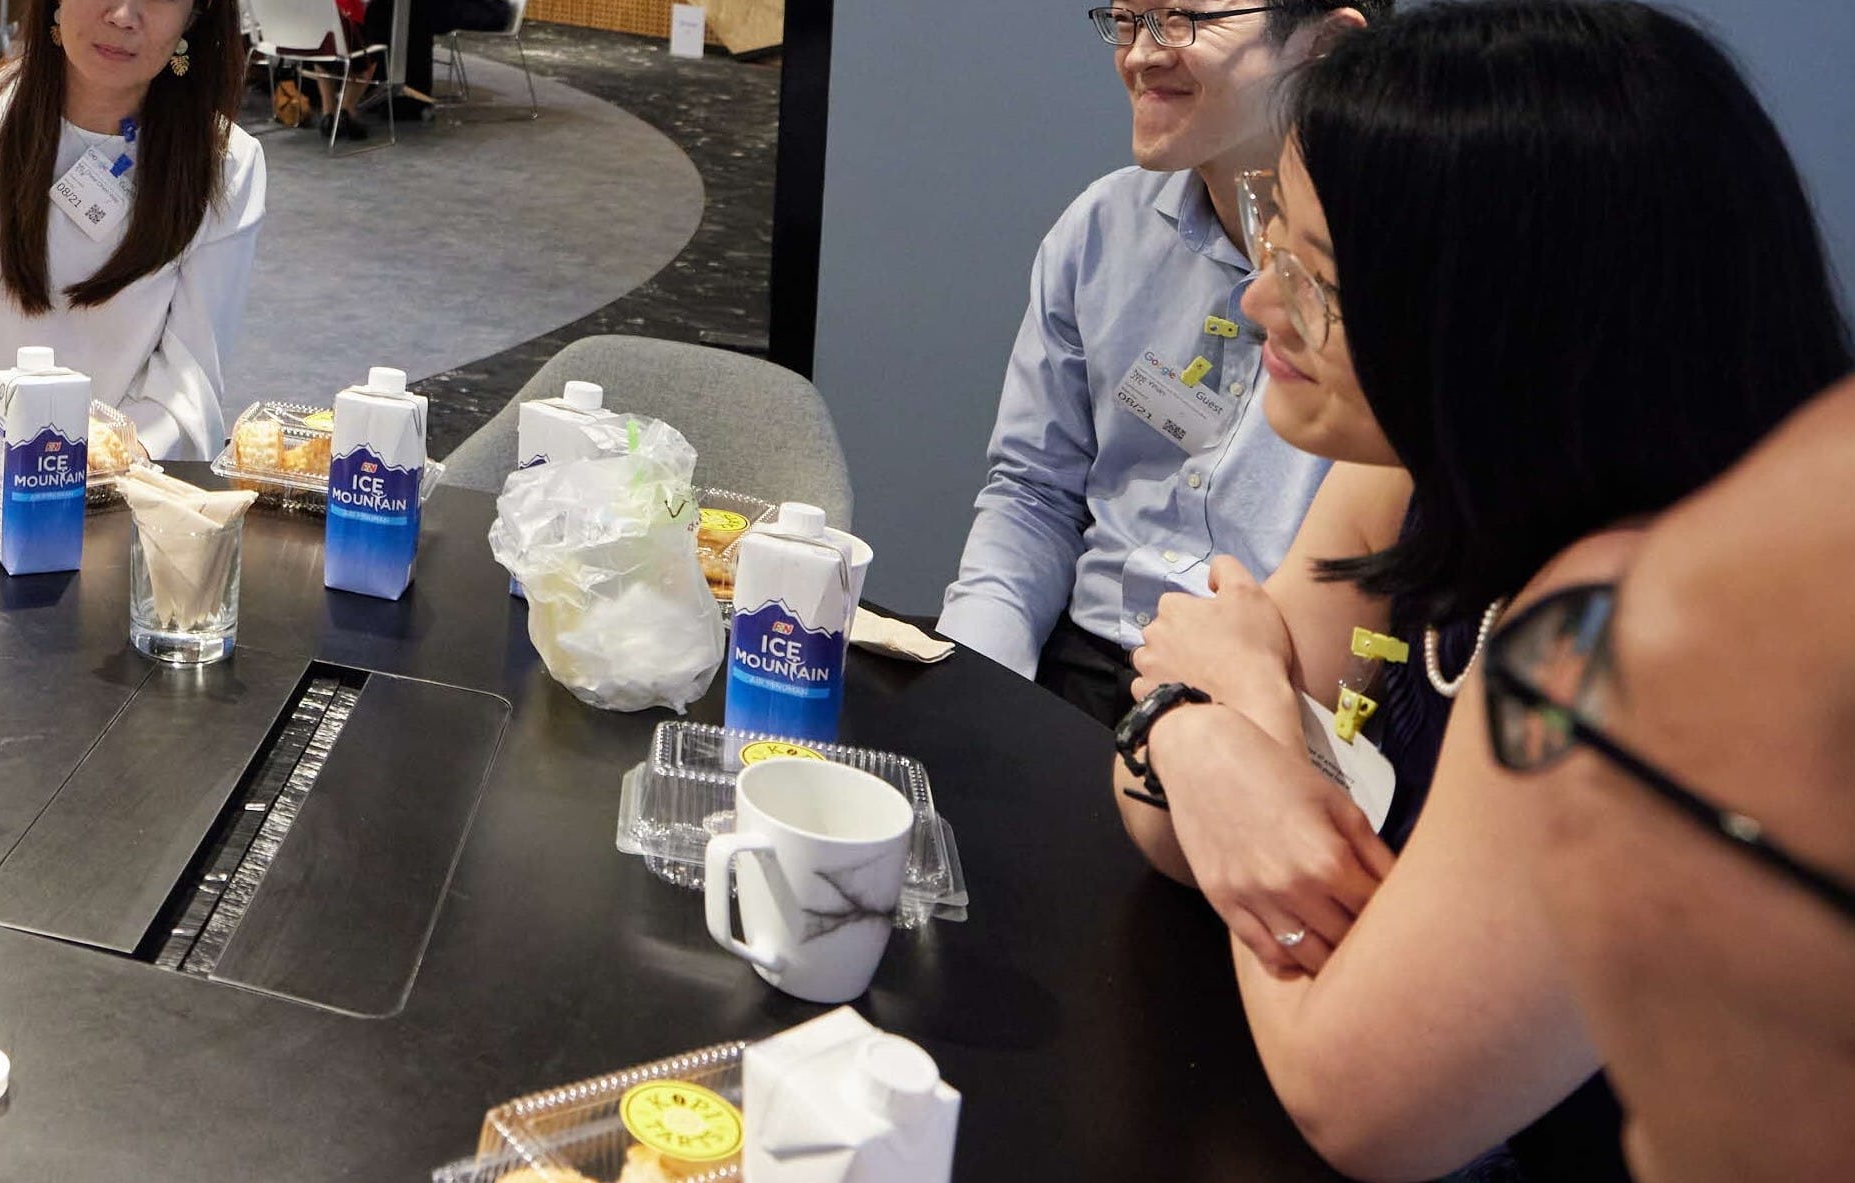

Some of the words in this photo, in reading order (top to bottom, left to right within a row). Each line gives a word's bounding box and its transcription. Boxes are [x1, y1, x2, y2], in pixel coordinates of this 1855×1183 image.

[57, 182, 82, 207] 08/21
[1118, 392, 1152, 420] 08/21
[1196, 391, 1223, 414] Guest
[38, 455, 69, 472] ICE
[14, 469, 85, 488] MOUNTAIN
[353, 475, 384, 494] ICE
[333, 487, 406, 511] MOUNTAIN
[761, 635, 802, 661] ICE
[735, 647, 829, 681] MOUNTAIN
